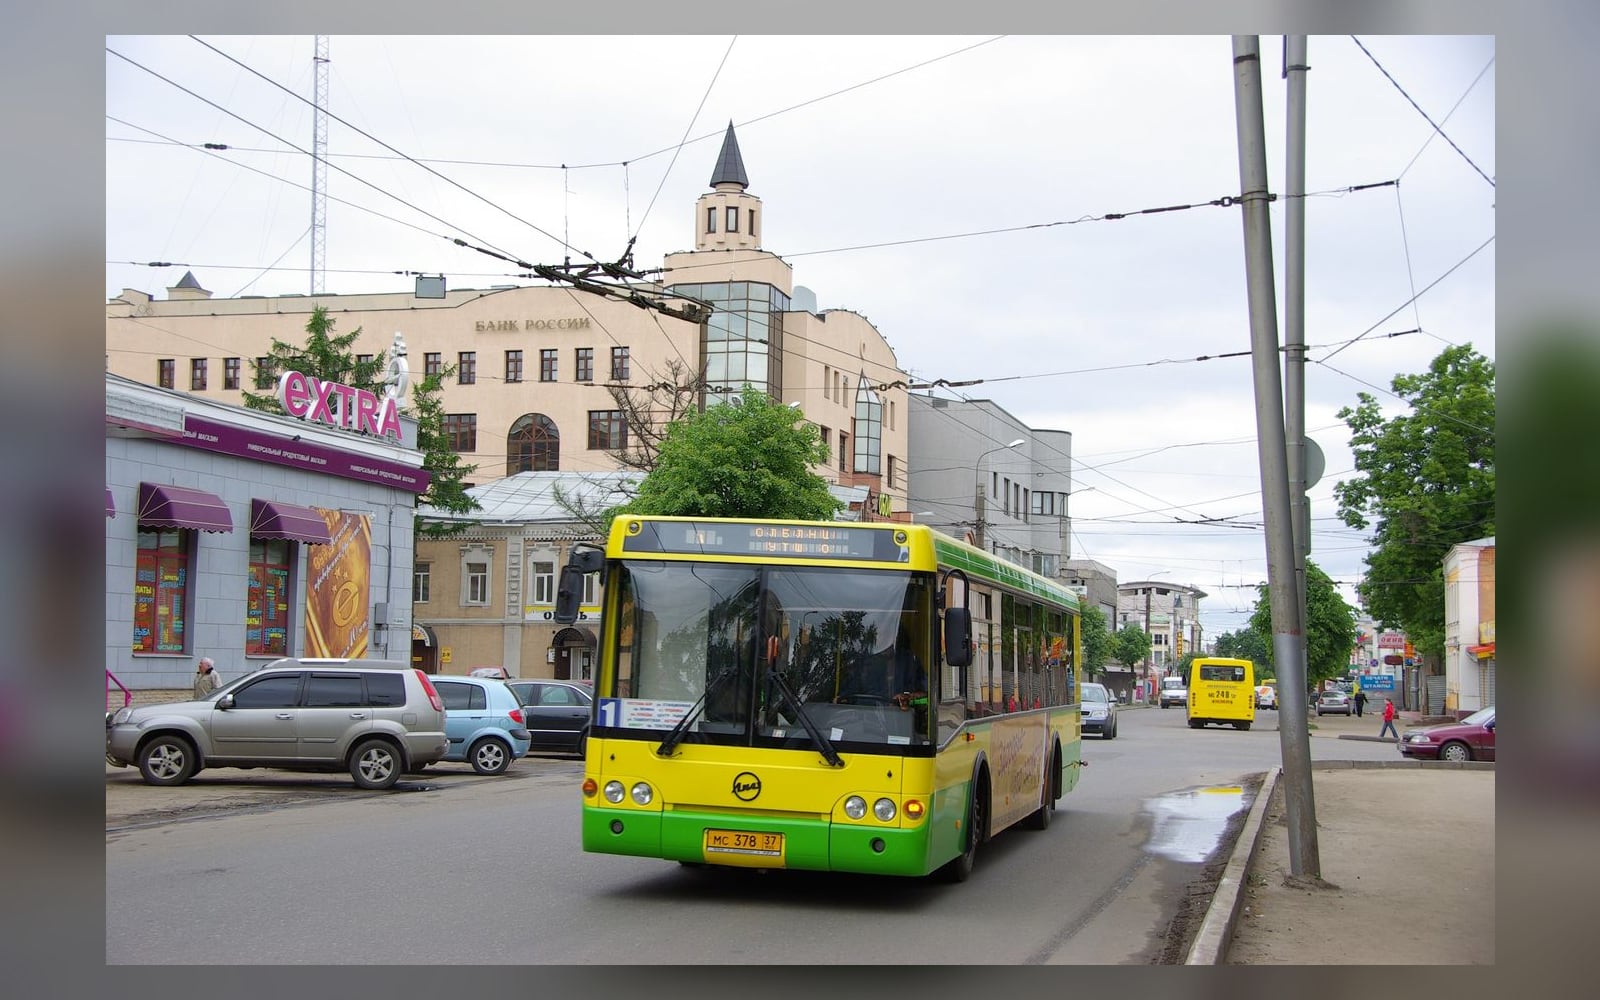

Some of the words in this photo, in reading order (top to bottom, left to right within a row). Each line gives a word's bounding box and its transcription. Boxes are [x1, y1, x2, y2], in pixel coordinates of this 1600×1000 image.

[475, 320, 520, 332] БАНК
[525, 317, 591, 331] РОССИИ
[198, 433, 219, 442] МАГАЗИН
[247, 443, 281, 456] УНИВЕРСАЛЬНЫЙ
[282, 450, 310, 461] ПРОДУКТОВЫЙ
[310, 457, 327, 465] МАГАЗИН
[601, 701, 615, 727] 1
[734, 833, 757, 847] 378
[764, 835, 777, 845] 37
